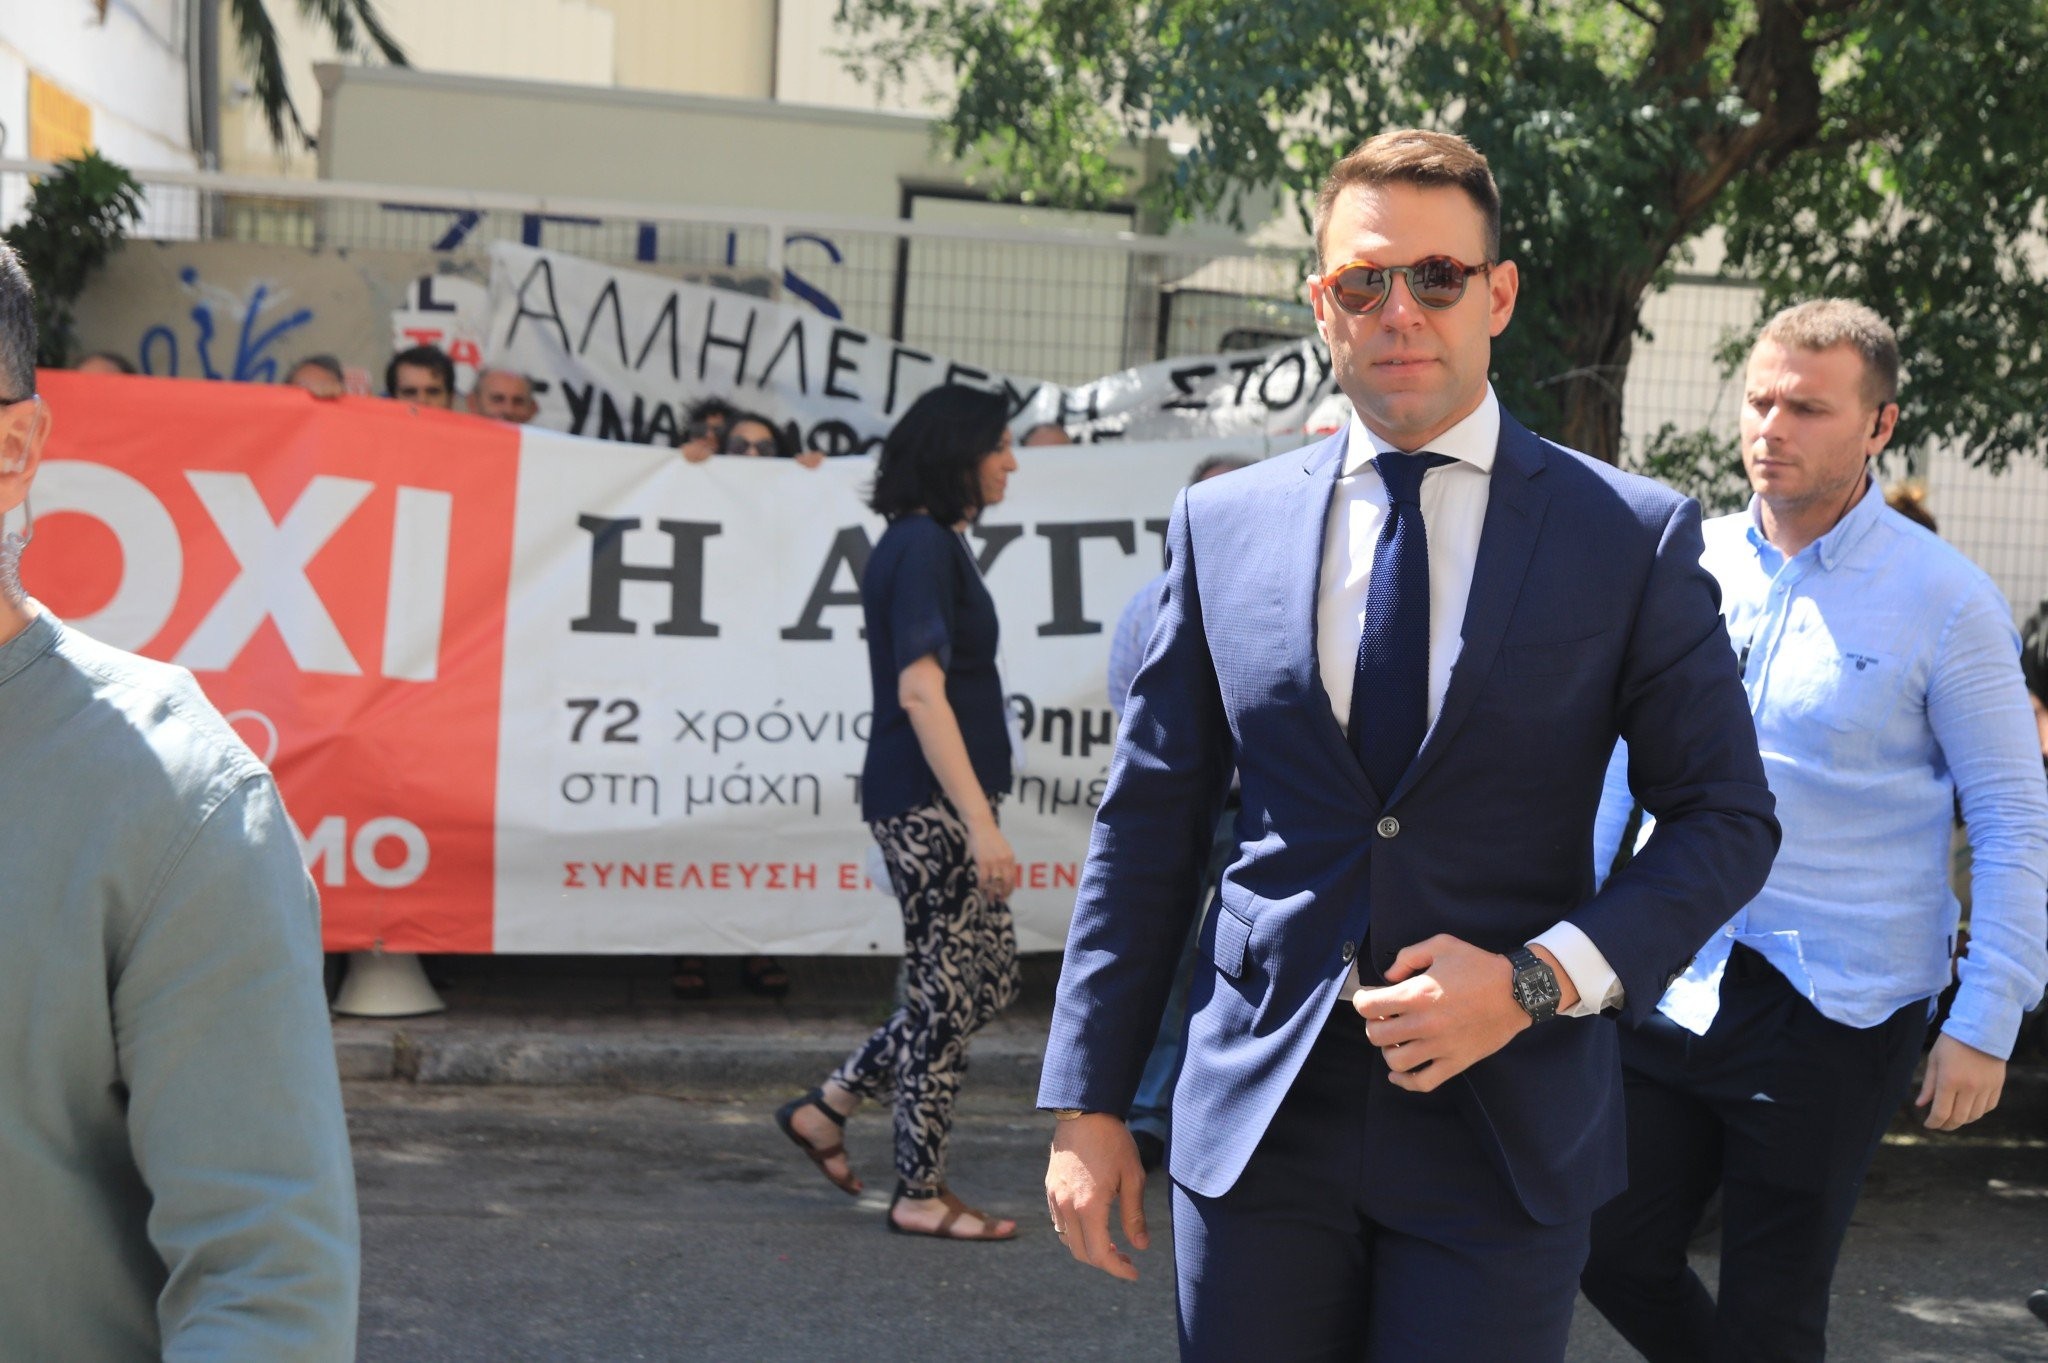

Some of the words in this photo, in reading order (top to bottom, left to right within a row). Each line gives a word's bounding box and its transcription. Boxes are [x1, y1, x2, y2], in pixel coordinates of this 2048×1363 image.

[1161, 344, 1343, 411] ΣΤΟΥ
[571, 513, 724, 638] Η
[565, 698, 641, 743] 72
[561, 772, 659, 816] στη
[685, 761, 820, 816] μάχη
[562, 861, 817, 890] ΣΥΝΕΛΕΥΣΗ
